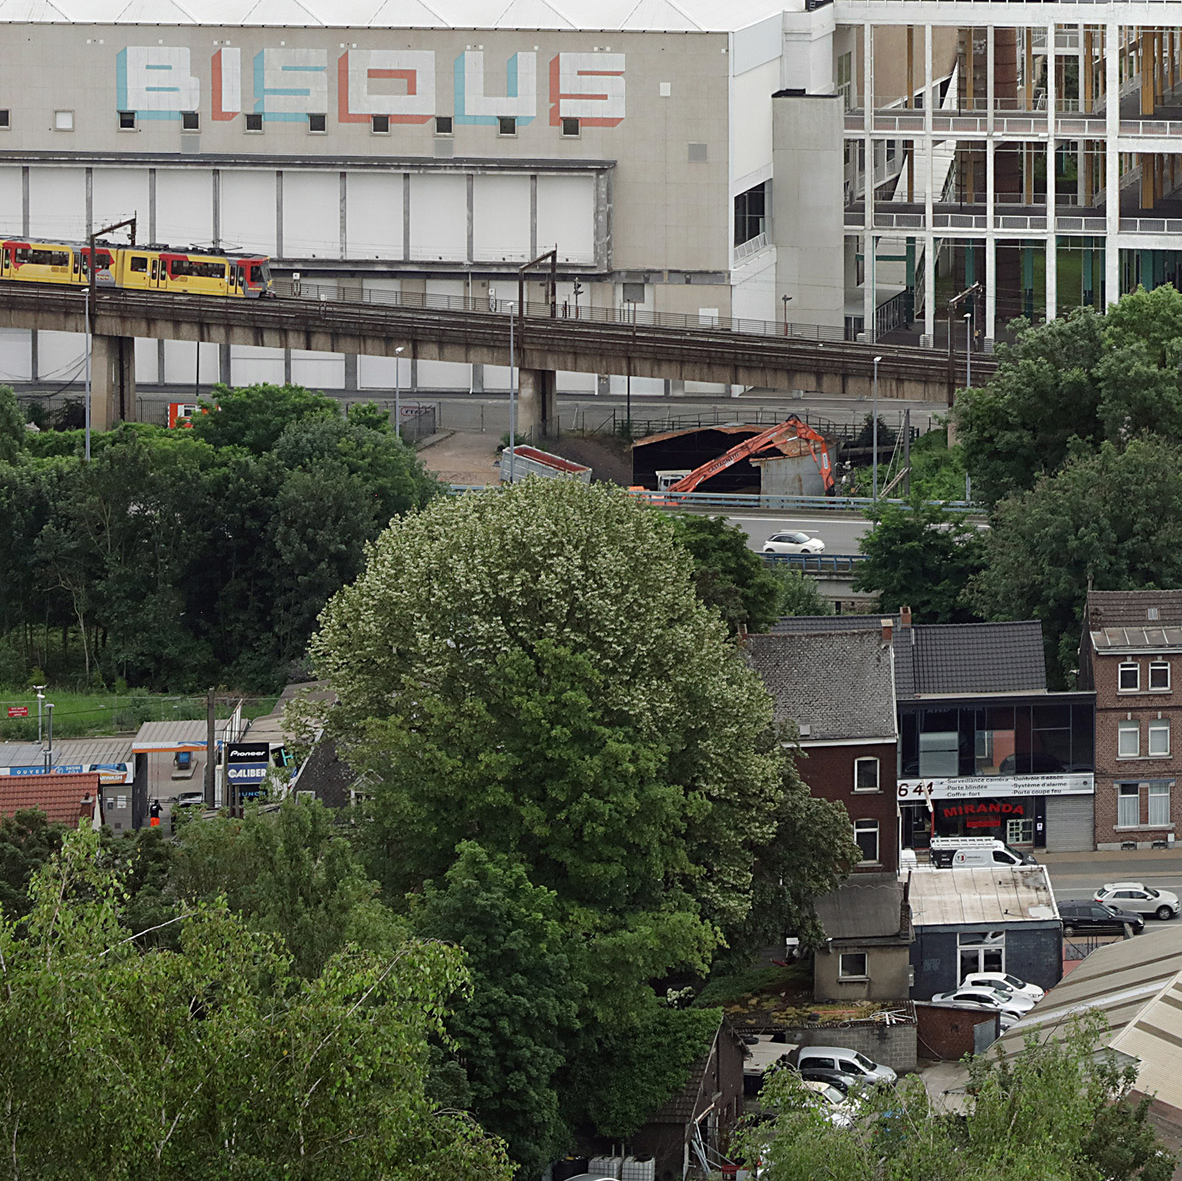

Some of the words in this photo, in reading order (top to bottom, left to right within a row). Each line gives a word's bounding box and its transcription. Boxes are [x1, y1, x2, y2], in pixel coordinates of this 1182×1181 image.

[116, 45, 625, 128] BISOUS
[227, 768, 267, 778] CALIBER
[943, 803, 1025, 818] MIRANDA
